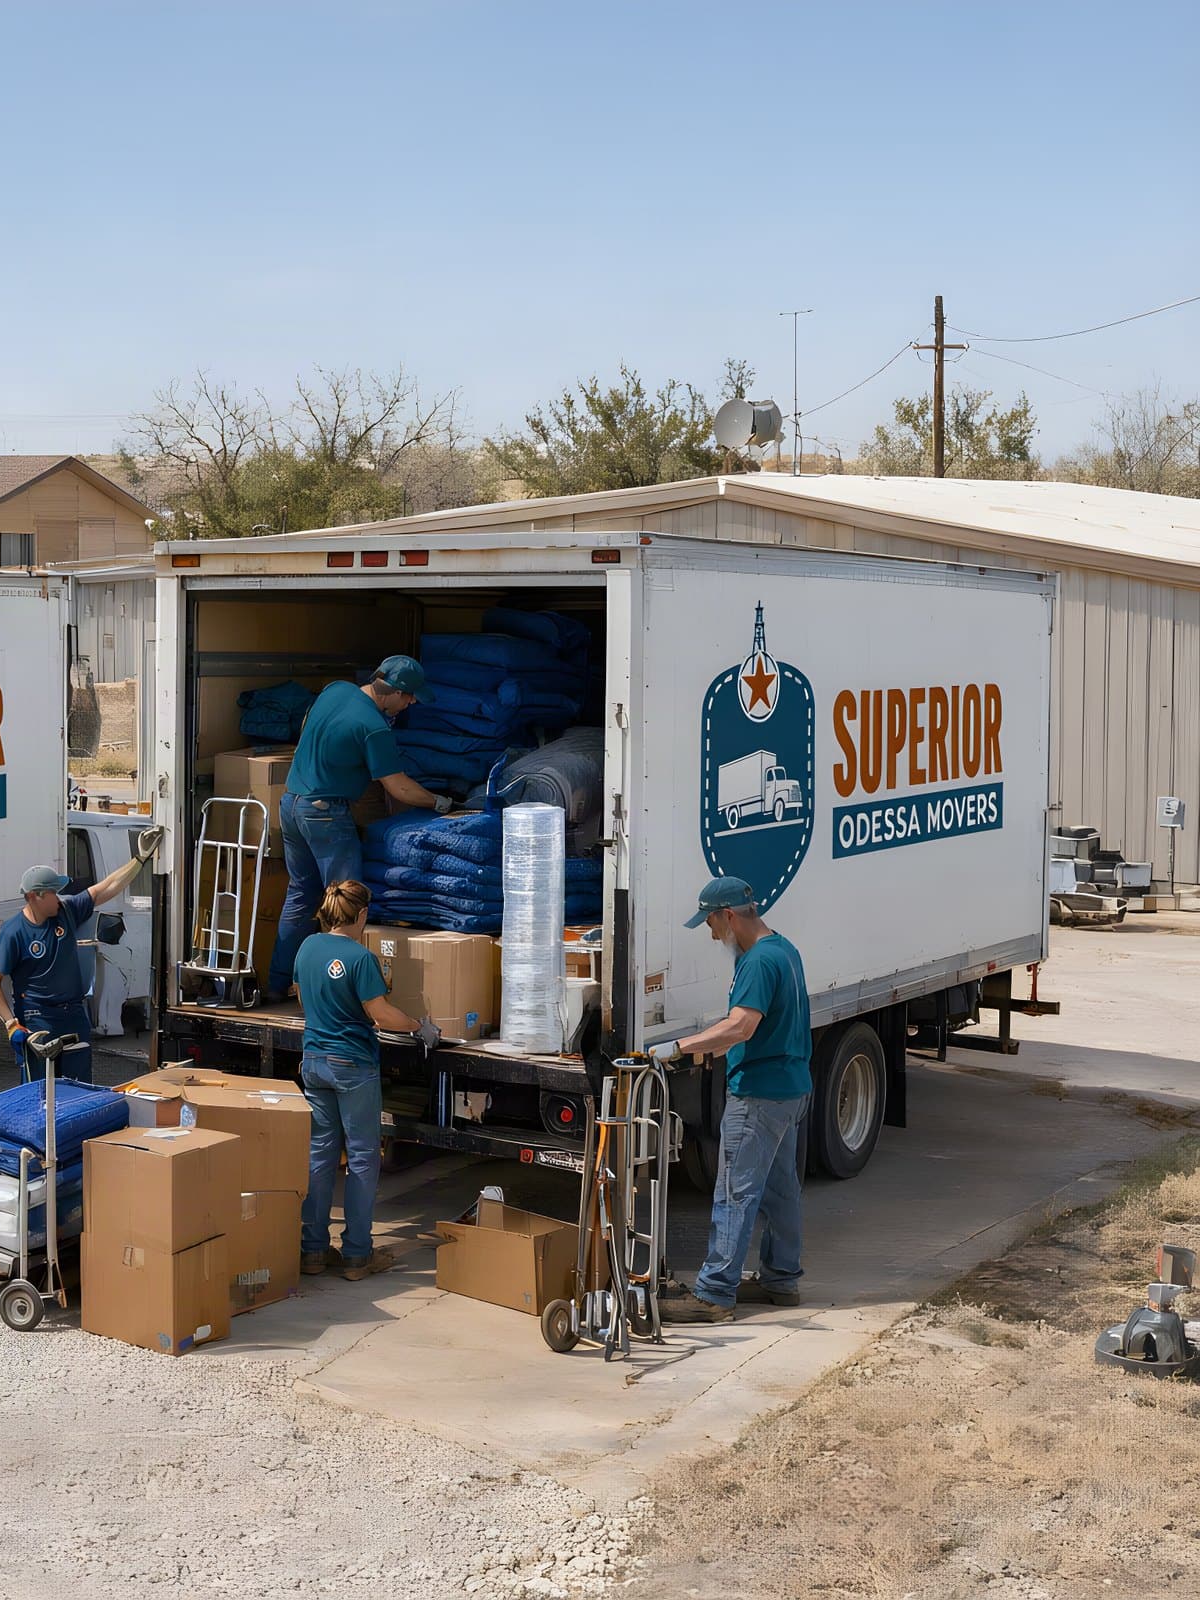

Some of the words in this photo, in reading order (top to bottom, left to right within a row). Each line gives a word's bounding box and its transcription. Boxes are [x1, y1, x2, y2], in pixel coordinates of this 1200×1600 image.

[833, 684, 1002, 797] SUPERIOR
[839, 804, 921, 849] ODESSA
[927, 791, 998, 833] MOVERS
